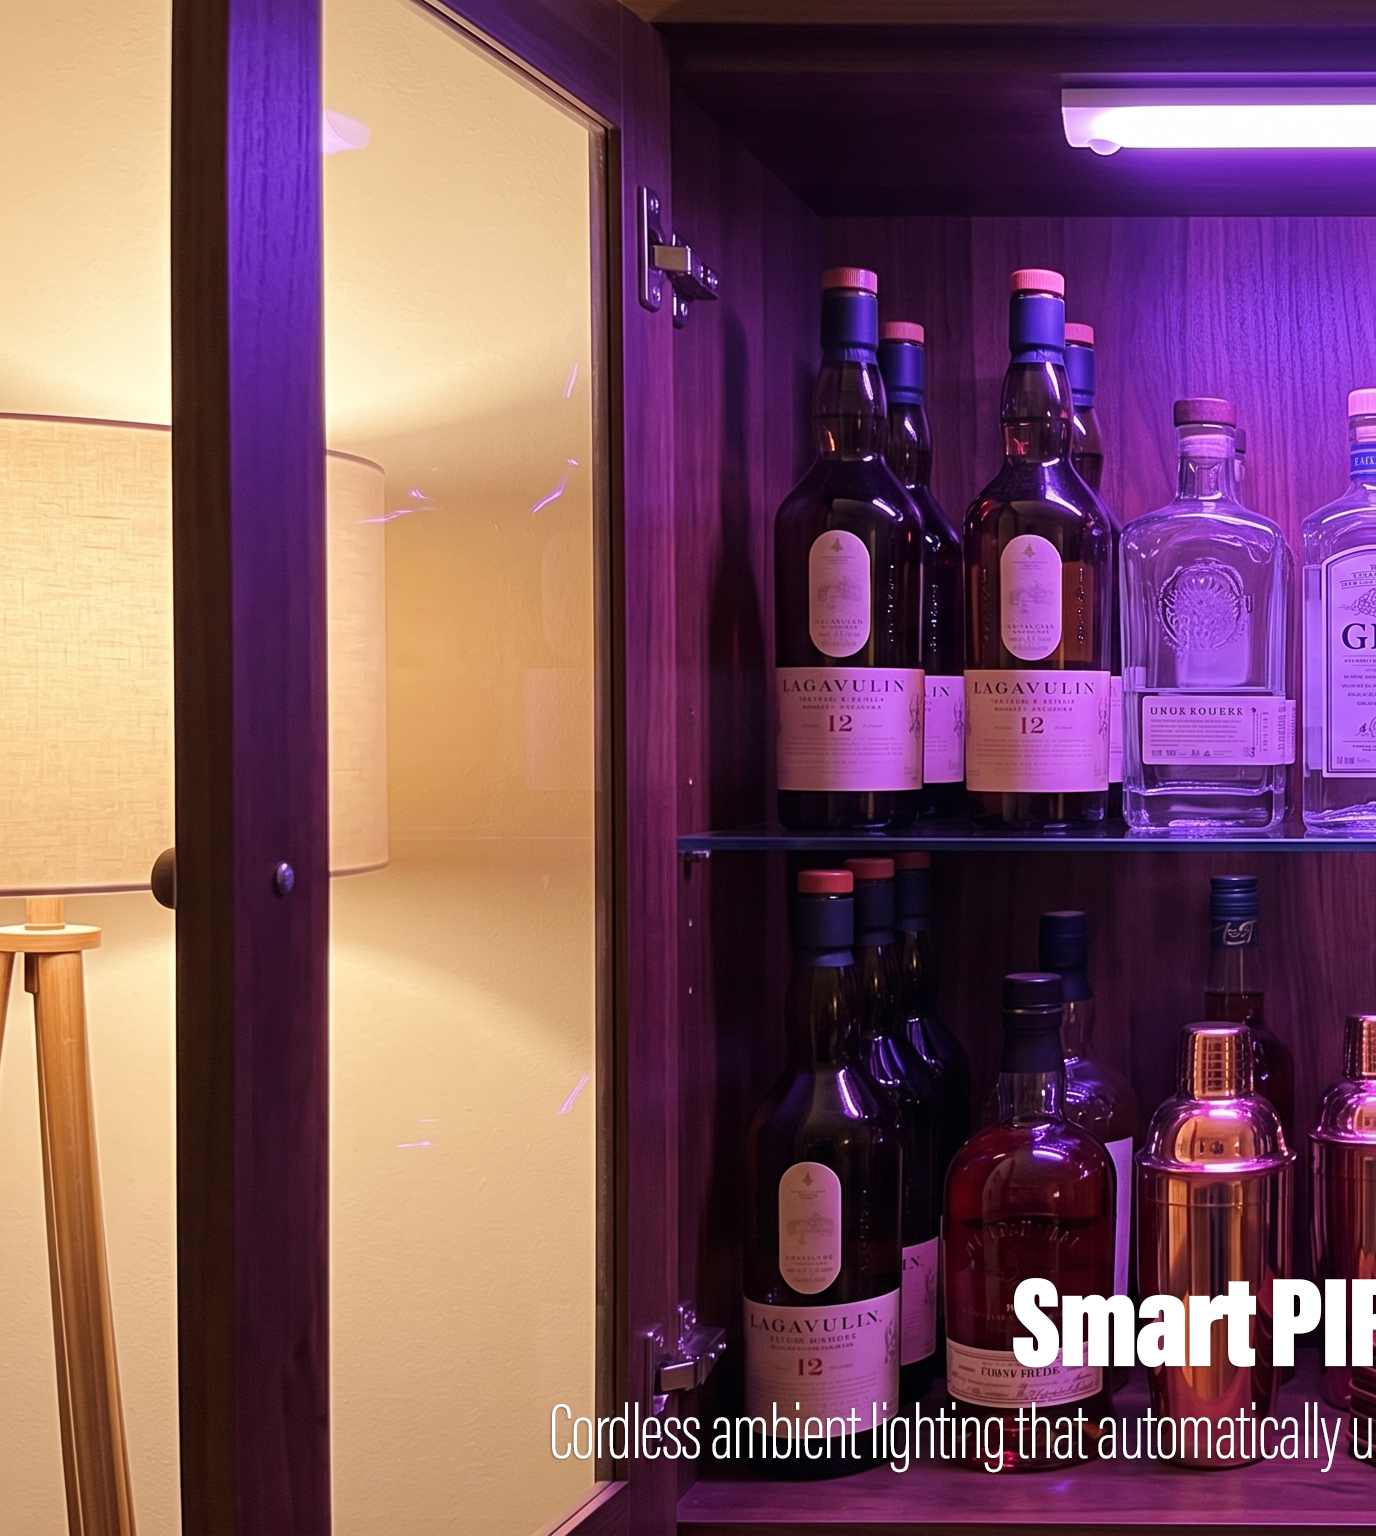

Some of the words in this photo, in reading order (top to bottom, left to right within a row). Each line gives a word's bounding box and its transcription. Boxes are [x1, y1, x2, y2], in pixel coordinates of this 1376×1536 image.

[783, 679, 905, 693] LAGAVULIN
[974, 681, 1095, 695] LAGAVULIN
[828, 714, 853, 733] 12
[1020, 716, 1045, 735] 12
[798, 1357, 823, 1376] 12
